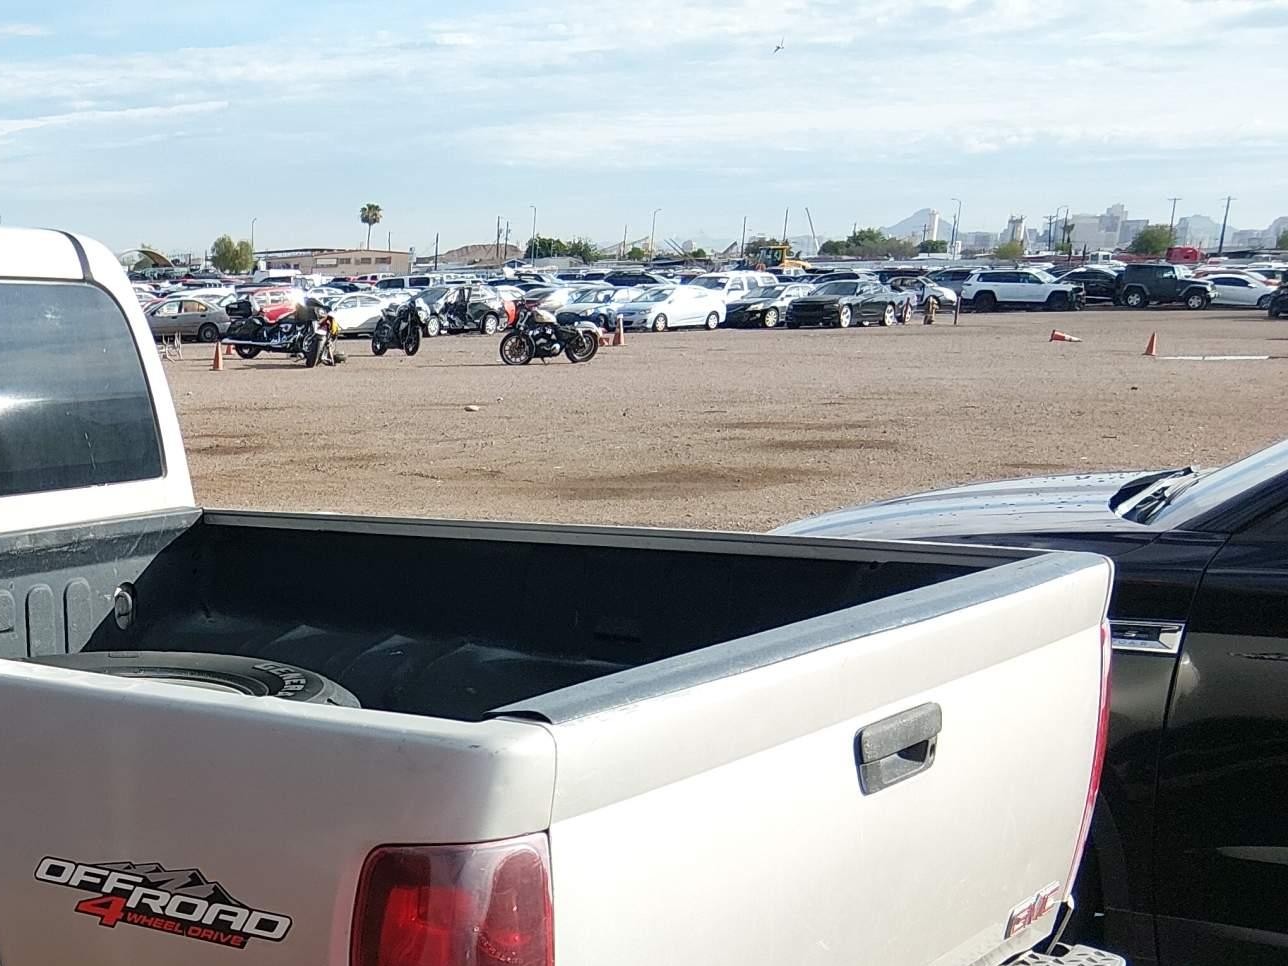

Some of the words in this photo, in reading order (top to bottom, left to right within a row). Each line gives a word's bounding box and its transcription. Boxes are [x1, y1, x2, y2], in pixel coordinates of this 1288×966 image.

[254, 662, 307, 697] GENERA
[76, 894, 126, 926] 4
[127, 911, 184, 934] WHEEL
[187, 925, 246, 947] DRIVE
